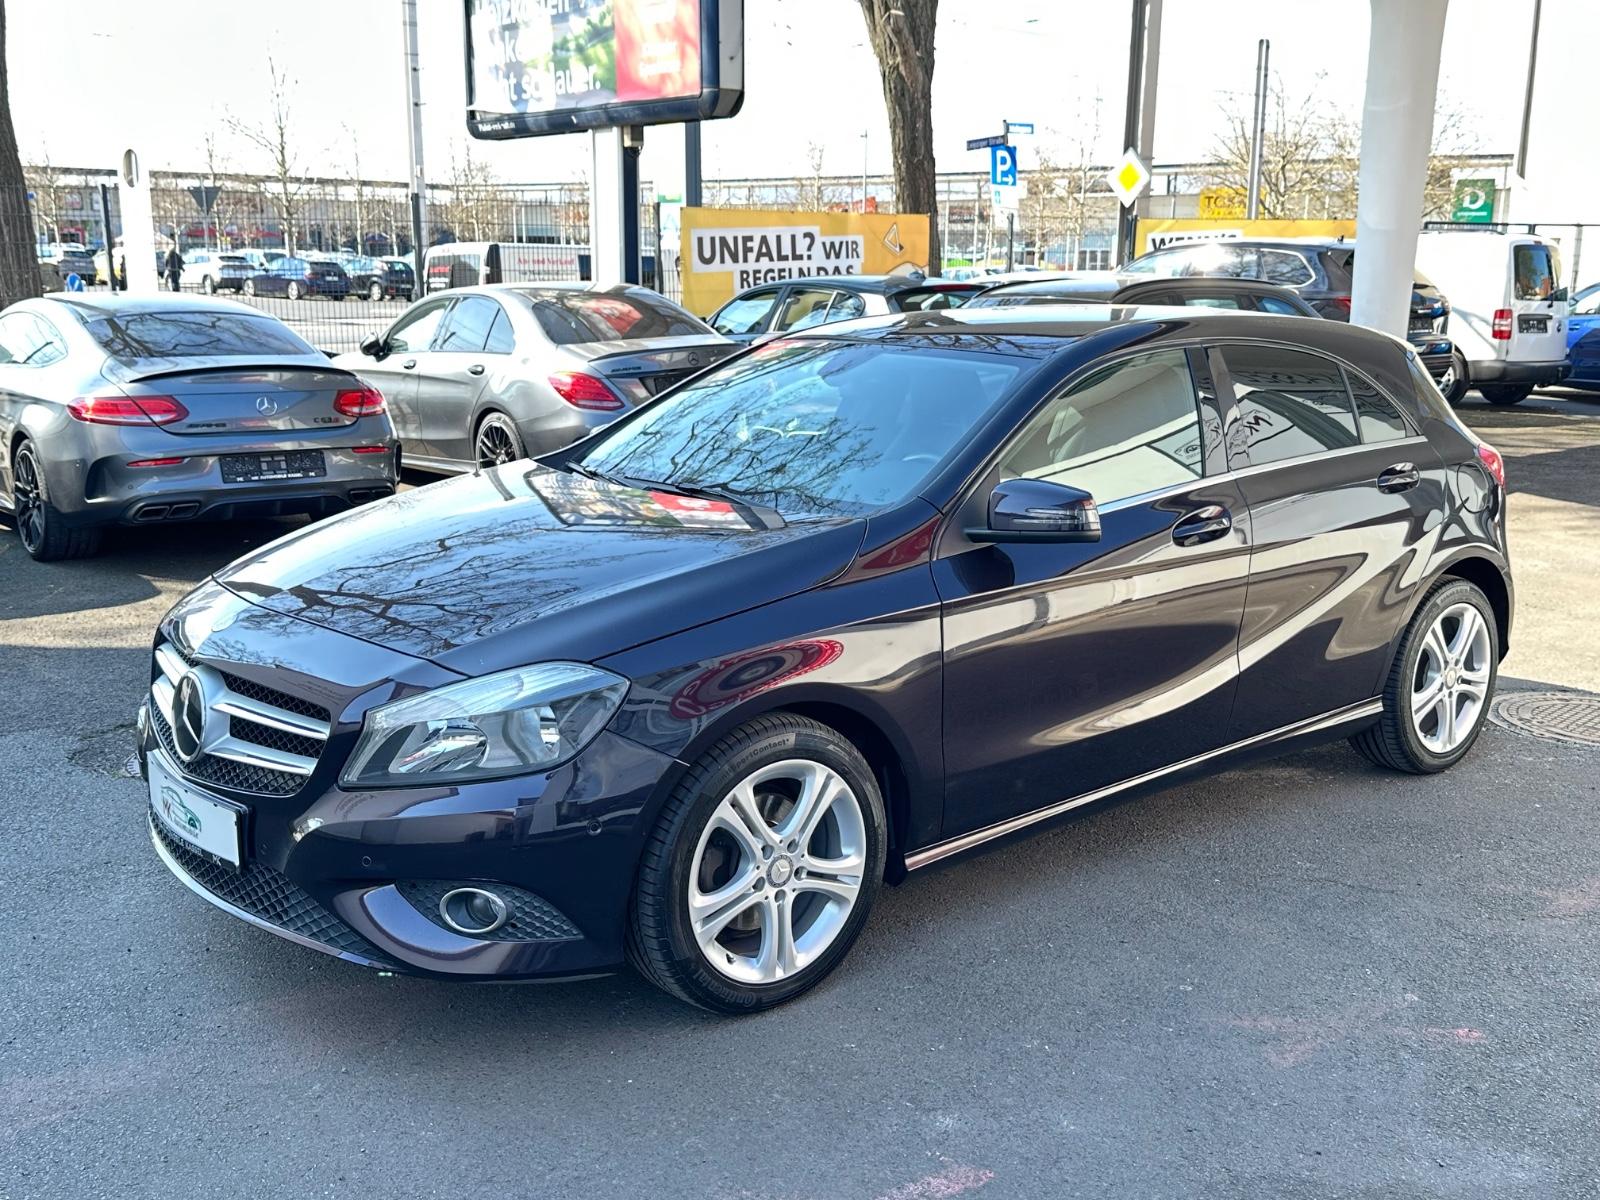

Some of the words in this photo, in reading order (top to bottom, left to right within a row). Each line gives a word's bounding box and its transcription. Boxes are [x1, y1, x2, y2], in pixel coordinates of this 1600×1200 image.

[996, 149, 1012, 183] P
[697, 232, 816, 265] UNFALL?
[821, 240, 860, 260] WIR
